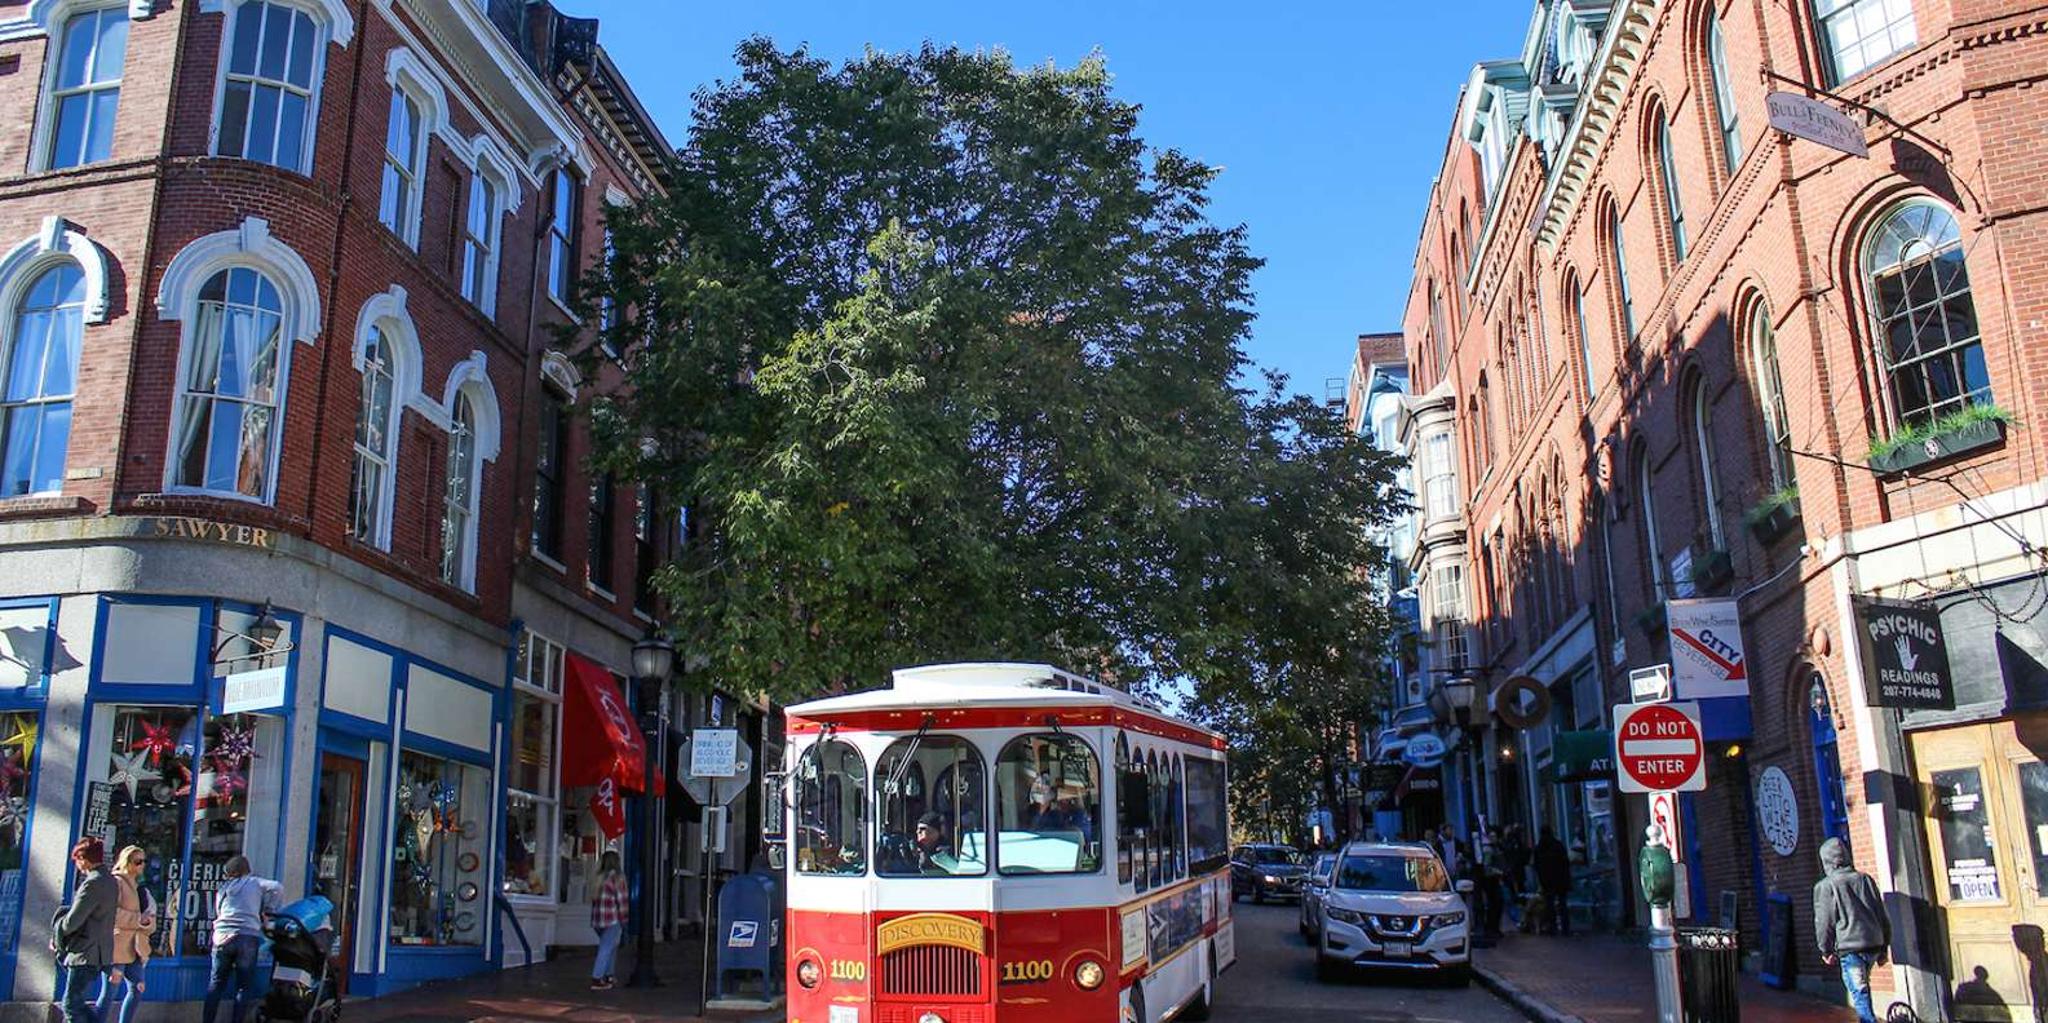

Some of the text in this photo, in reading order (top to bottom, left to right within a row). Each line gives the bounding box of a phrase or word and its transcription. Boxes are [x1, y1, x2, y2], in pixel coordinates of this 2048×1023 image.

[155, 518, 269, 548] SAWYER
[1868, 613, 1937, 646] PSYCHIC
[1698, 629, 1741, 662] CITY
[1672, 639, 1728, 680] BEVERAGE
[1880, 668, 1940, 686] READINGS
[1629, 721, 1688, 736] DO NOT
[1637, 760, 1686, 775] ENTER
[1963, 881, 1993, 898] OPEN
[883, 919, 981, 945] DISCOVERY
[830, 959, 865, 981] 1100
[1003, 959, 1054, 982] 1100
